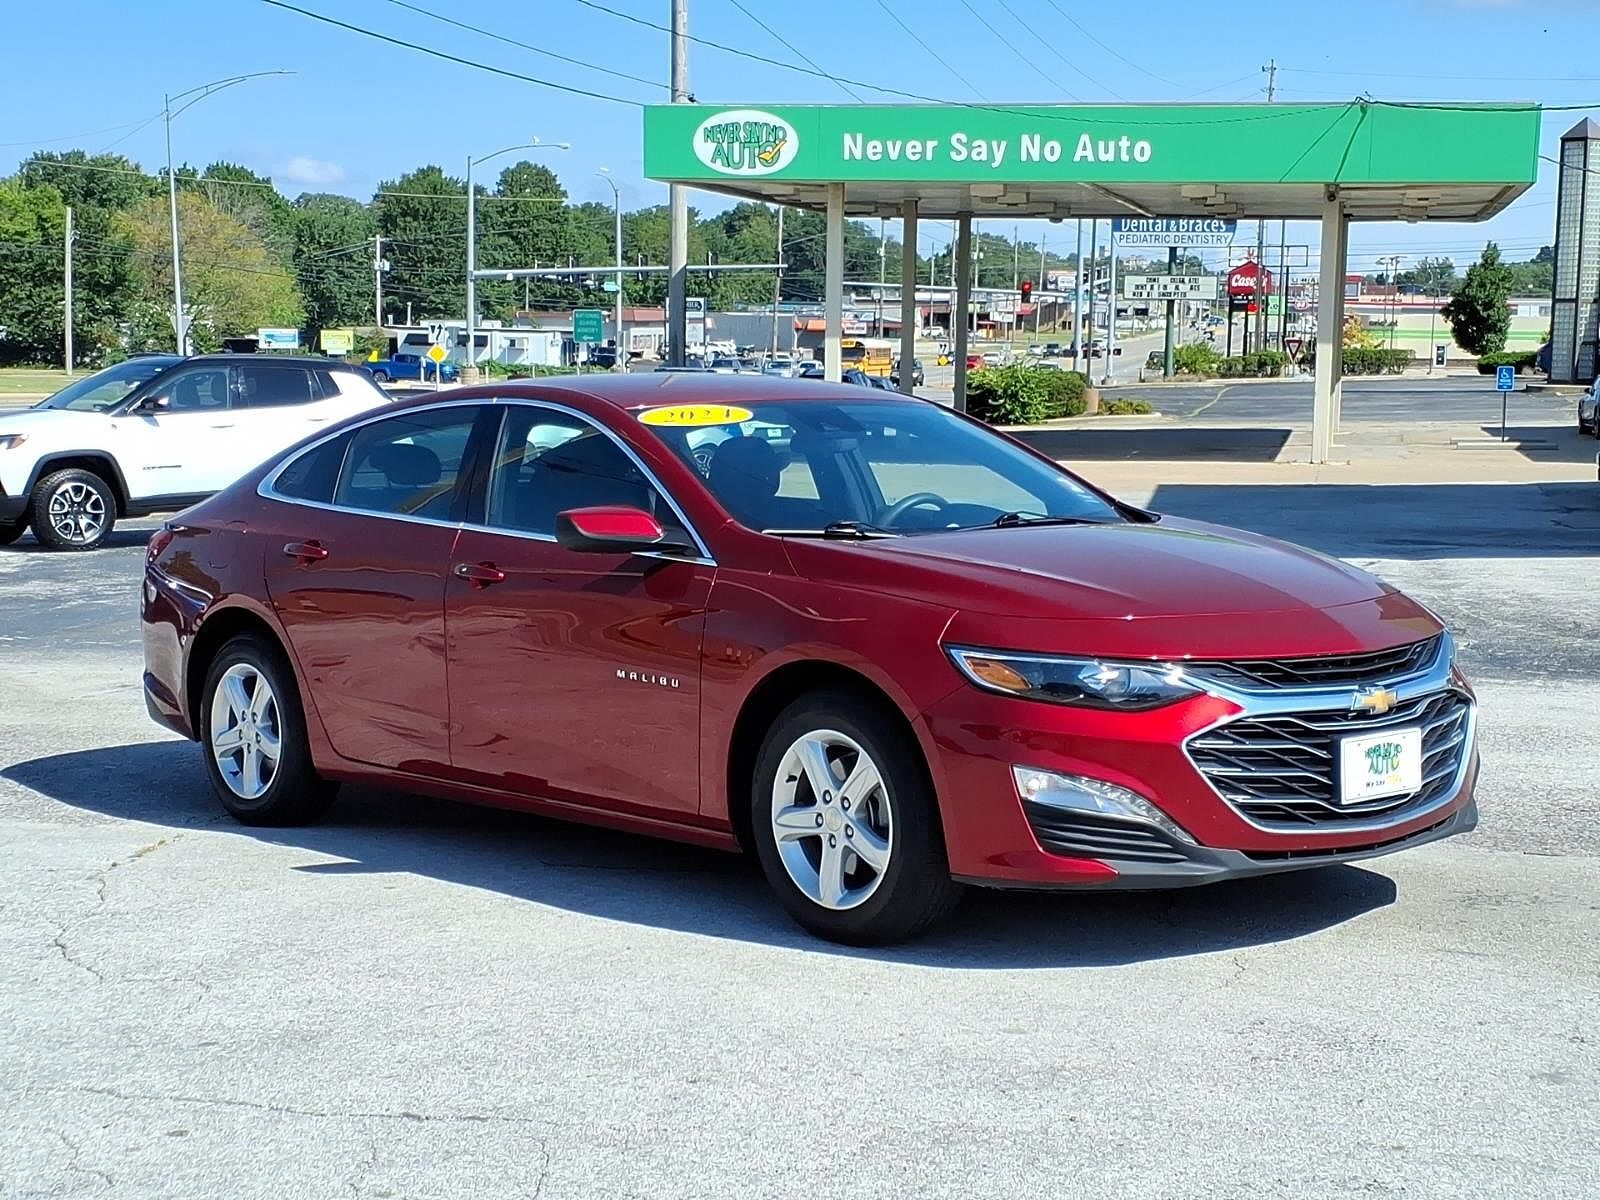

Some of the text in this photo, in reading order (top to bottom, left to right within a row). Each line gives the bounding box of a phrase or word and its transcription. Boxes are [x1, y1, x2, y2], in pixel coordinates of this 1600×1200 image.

[703, 122, 742, 143] NEVER
[710, 141, 781, 169] AUTO
[843, 133, 1151, 168] Never Say No Auto
[1121, 219, 1226, 232] Dental & Braces
[1119, 234, 1230, 244] PEDIATRIC DENTISTRY
[616, 669, 679, 688] MALIBU
